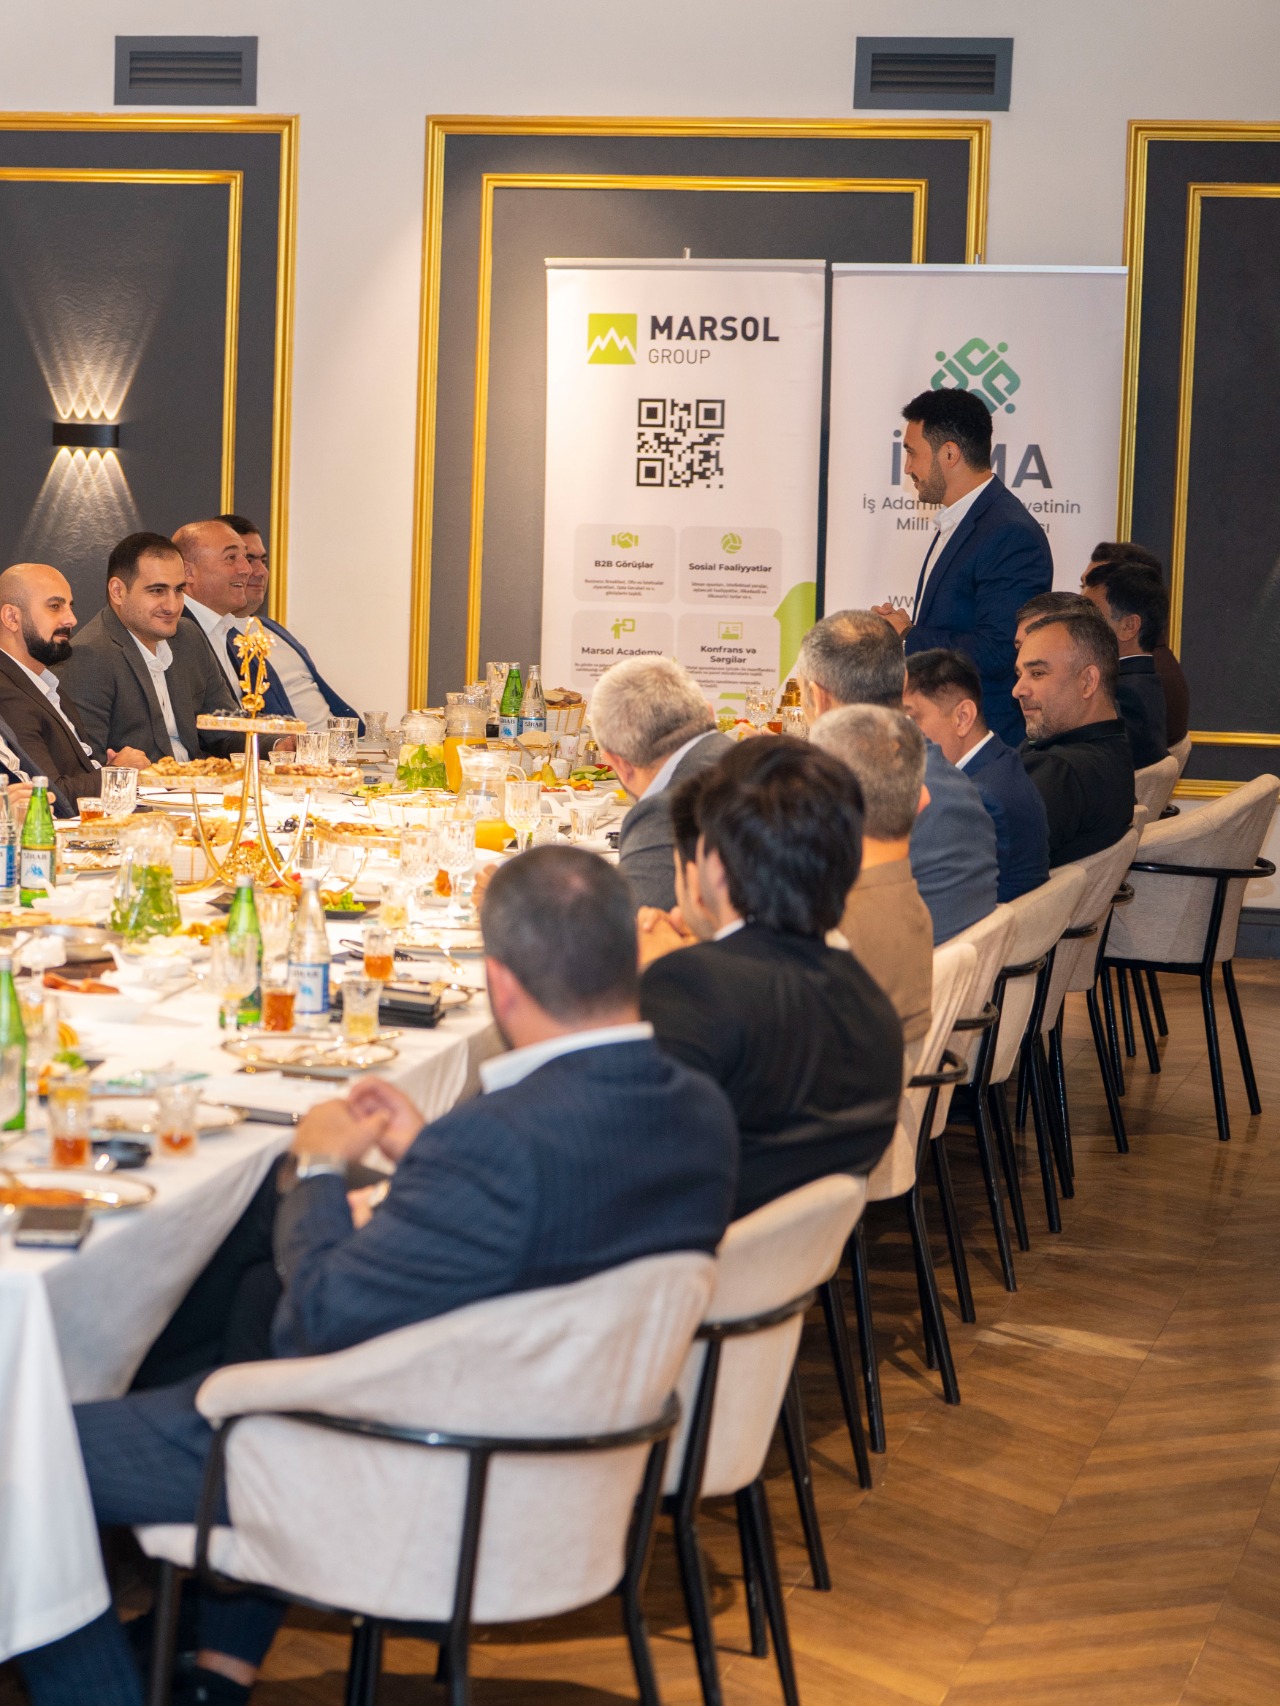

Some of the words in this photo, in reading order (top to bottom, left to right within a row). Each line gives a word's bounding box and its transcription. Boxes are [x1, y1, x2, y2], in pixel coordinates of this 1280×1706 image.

[650, 315, 780, 342] MARSOL
[648, 348, 711, 364] GROUP
[896, 516, 929, 531] Milli
[594, 560, 613, 568] B2B
[688, 562, 716, 571] Sosial
[581, 647, 614, 655] Marsol
[700, 645, 744, 654] Konfrans
